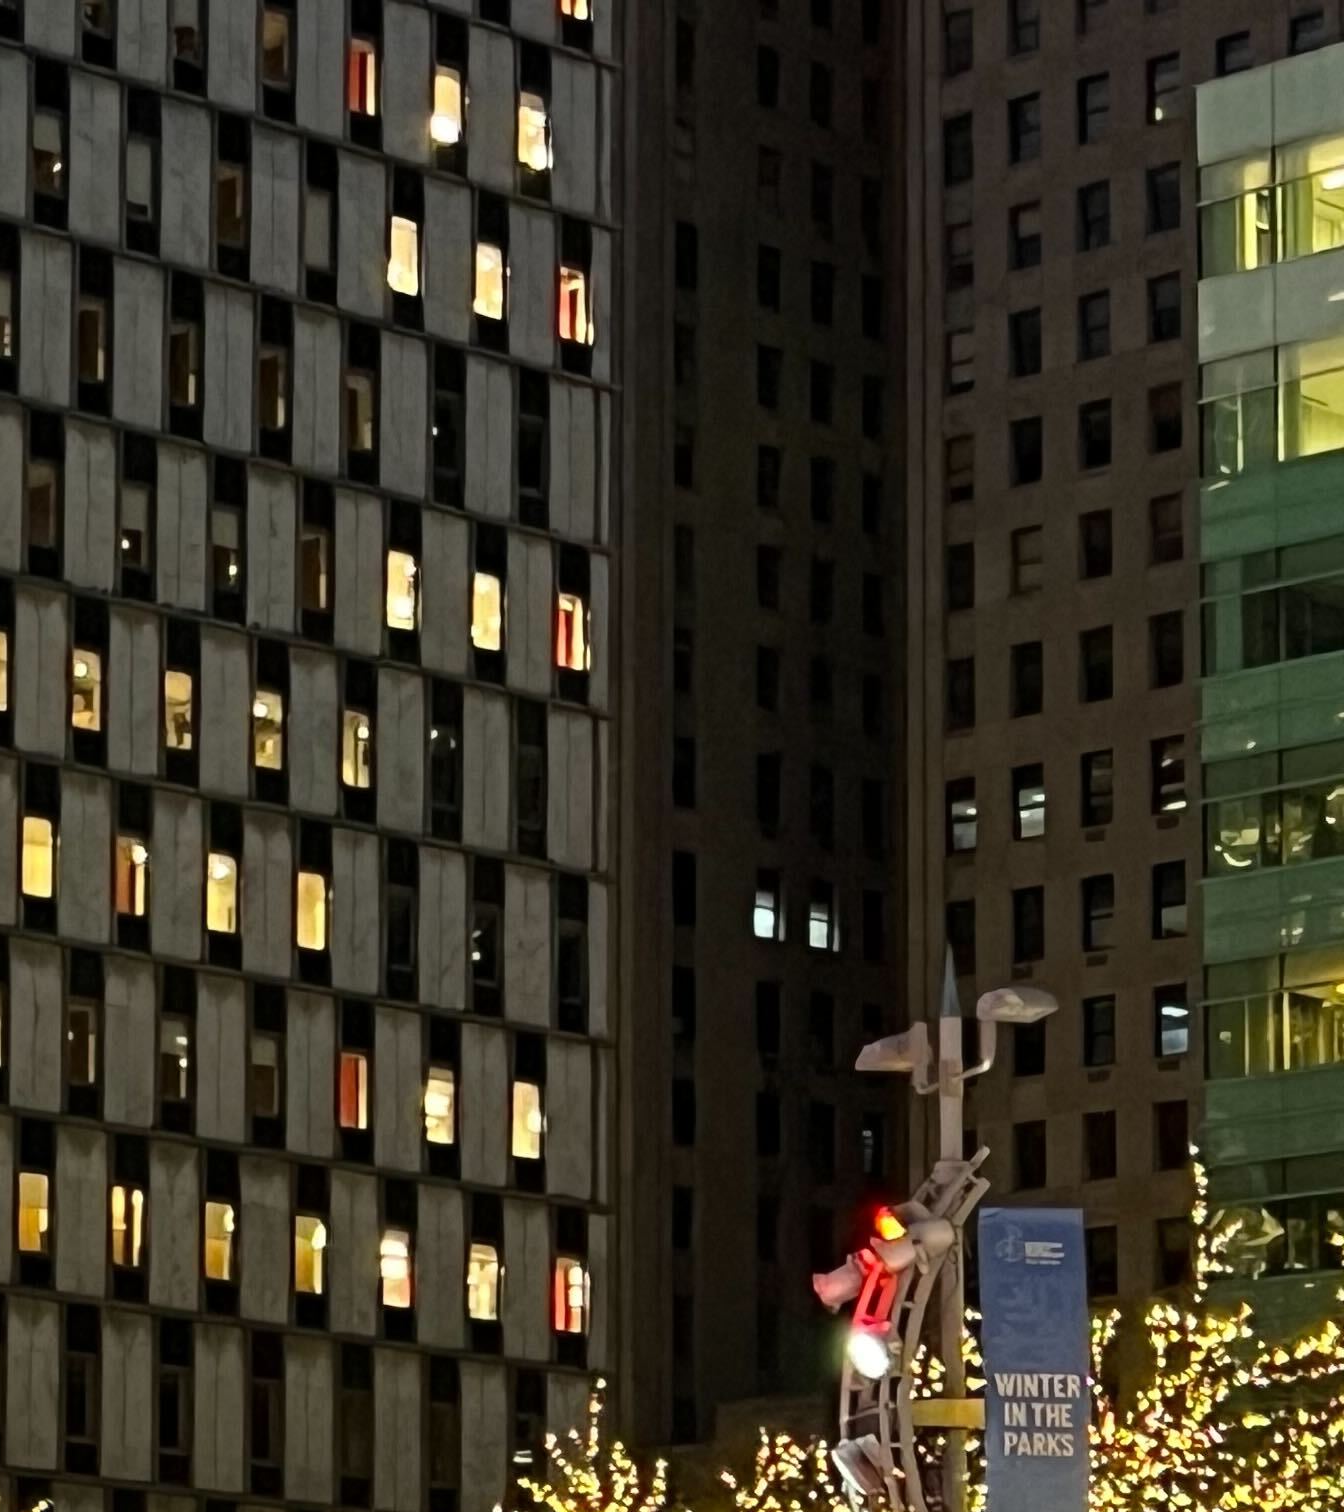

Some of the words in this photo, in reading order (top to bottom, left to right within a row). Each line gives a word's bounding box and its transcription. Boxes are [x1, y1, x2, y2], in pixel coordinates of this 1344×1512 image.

[994, 1373, 1081, 1398] WINTER
[1004, 1402, 1027, 1428] IN
[1031, 1403, 1073, 1428] THE
[1004, 1431, 1074, 1456] PARKS
